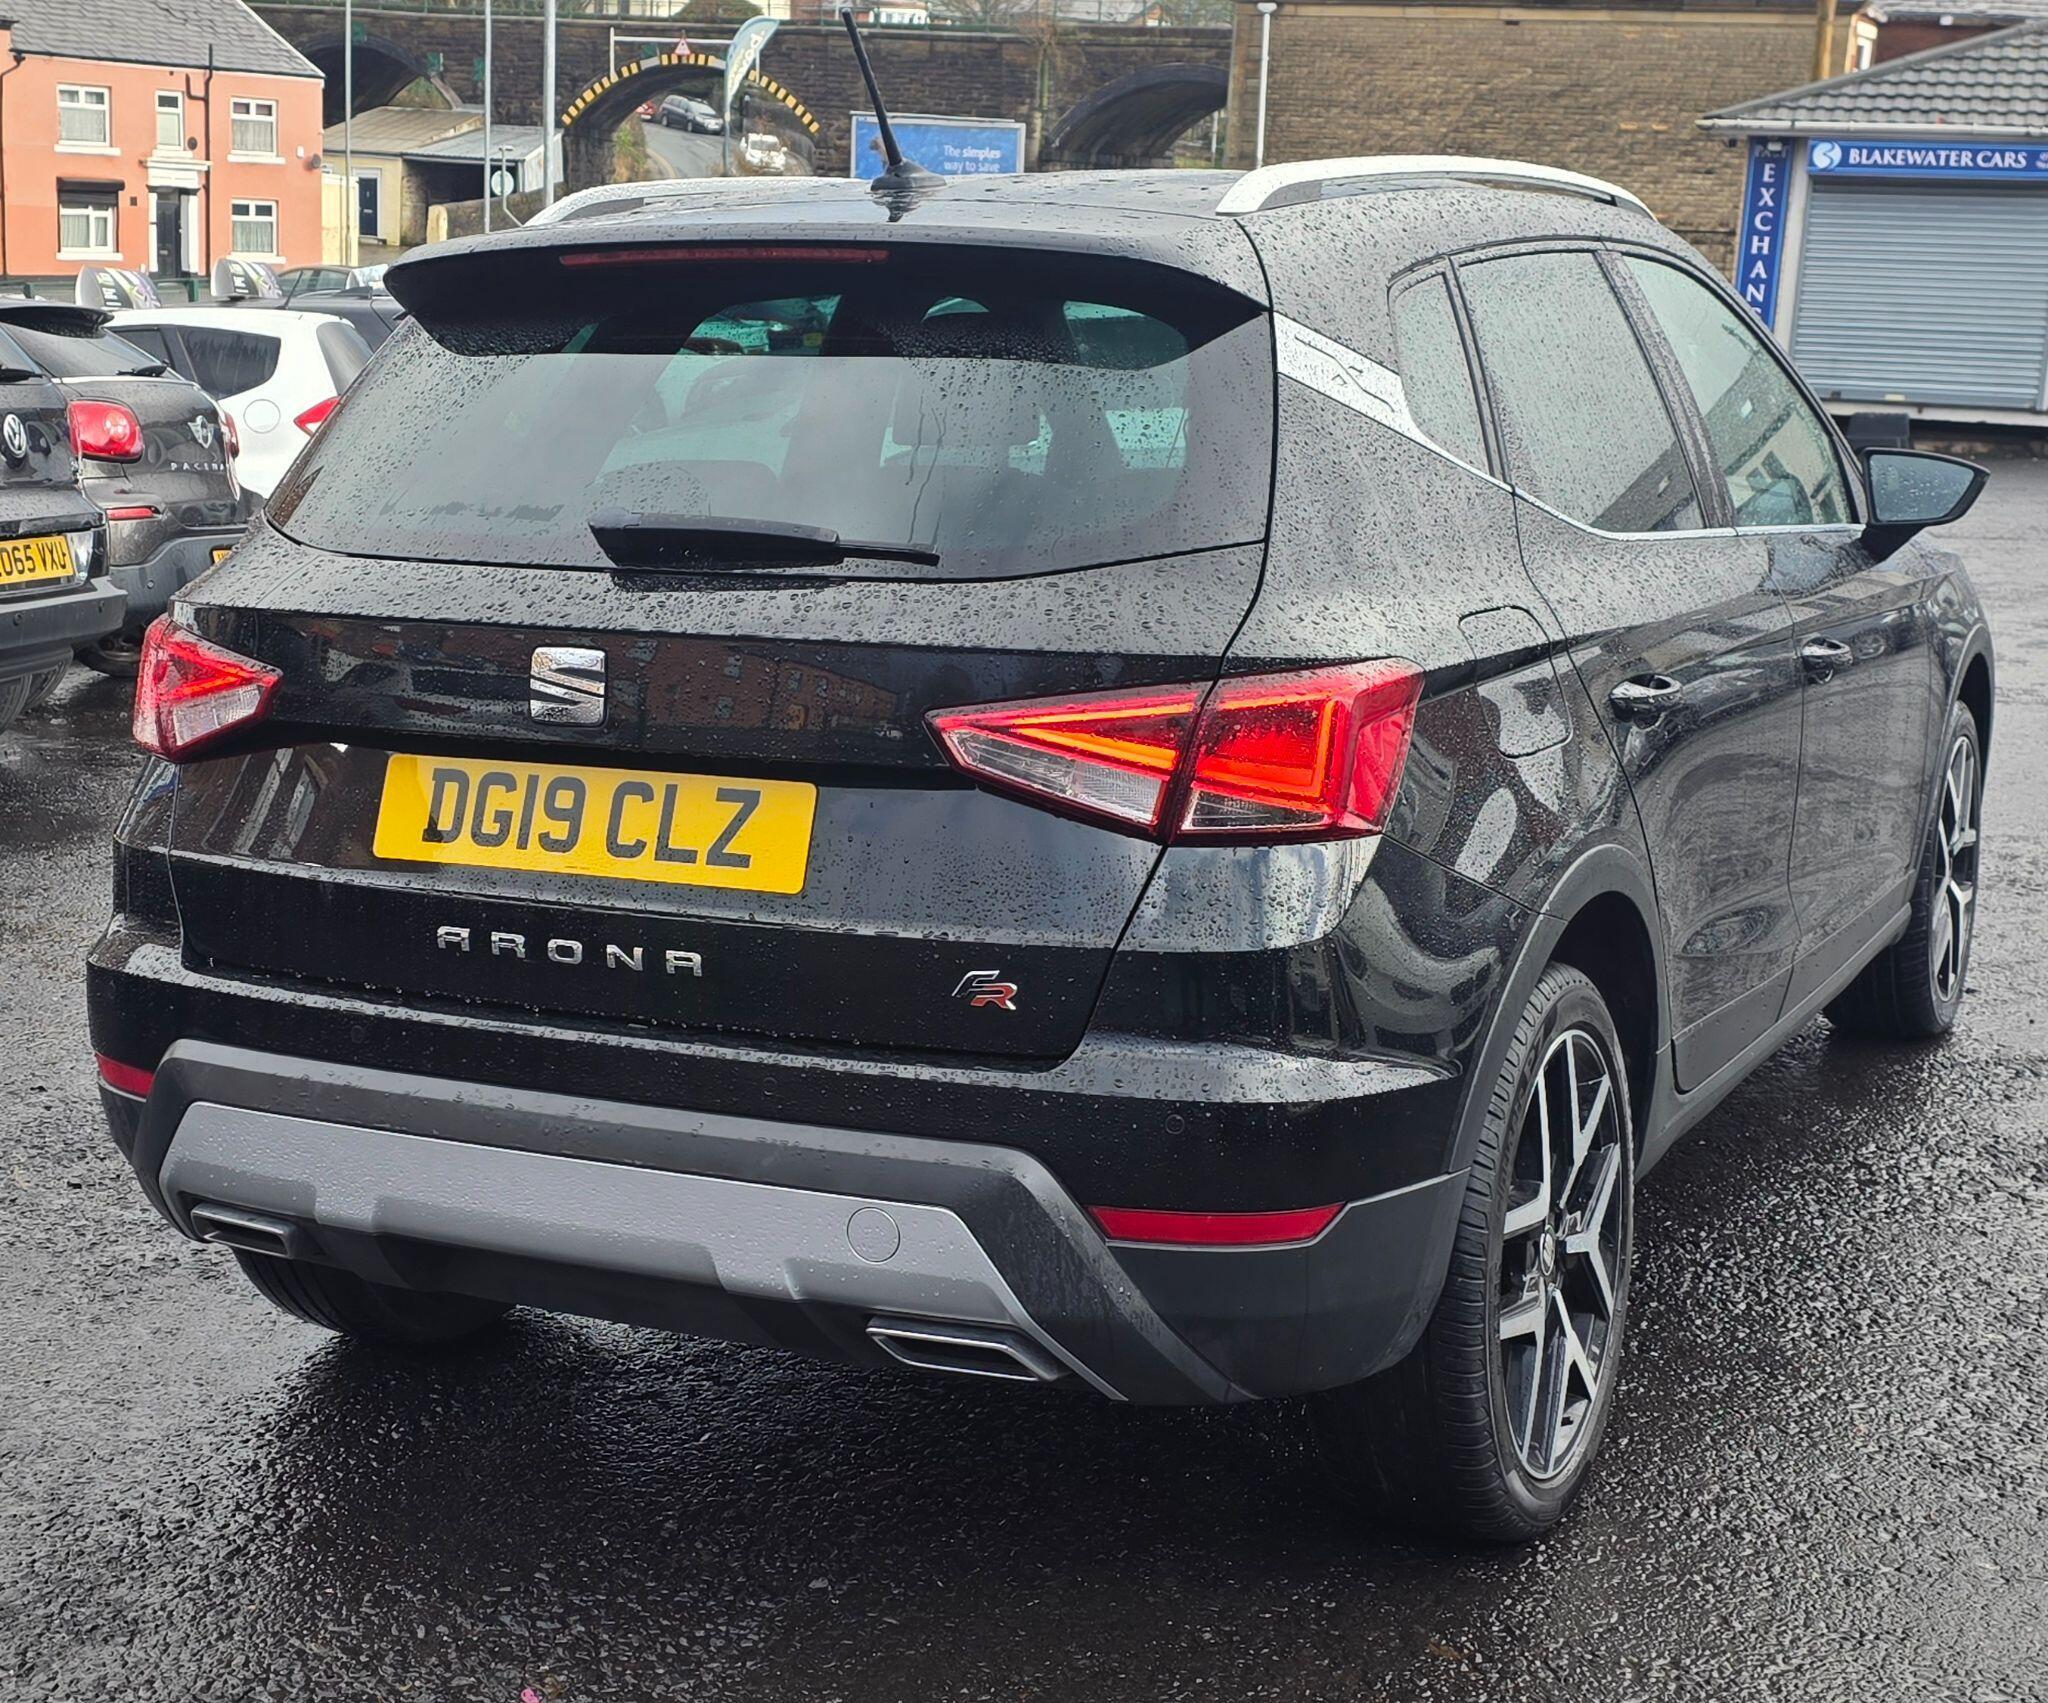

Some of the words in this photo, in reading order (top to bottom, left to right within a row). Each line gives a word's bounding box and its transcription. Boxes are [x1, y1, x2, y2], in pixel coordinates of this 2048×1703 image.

[943, 144, 961, 157] The
[962, 145, 1001, 161] simples
[943, 160, 964, 174] way
[965, 160, 977, 172] to
[978, 161, 1000, 173] save
[1849, 148, 1974, 168] BLAKEWATER
[1976, 150, 2027, 169] CARS
[422, 767, 587, 853] DG19
[605, 780, 762, 869] CLZ
[436, 925, 704, 977] ARONA
[950, 969, 1018, 1011] FR
